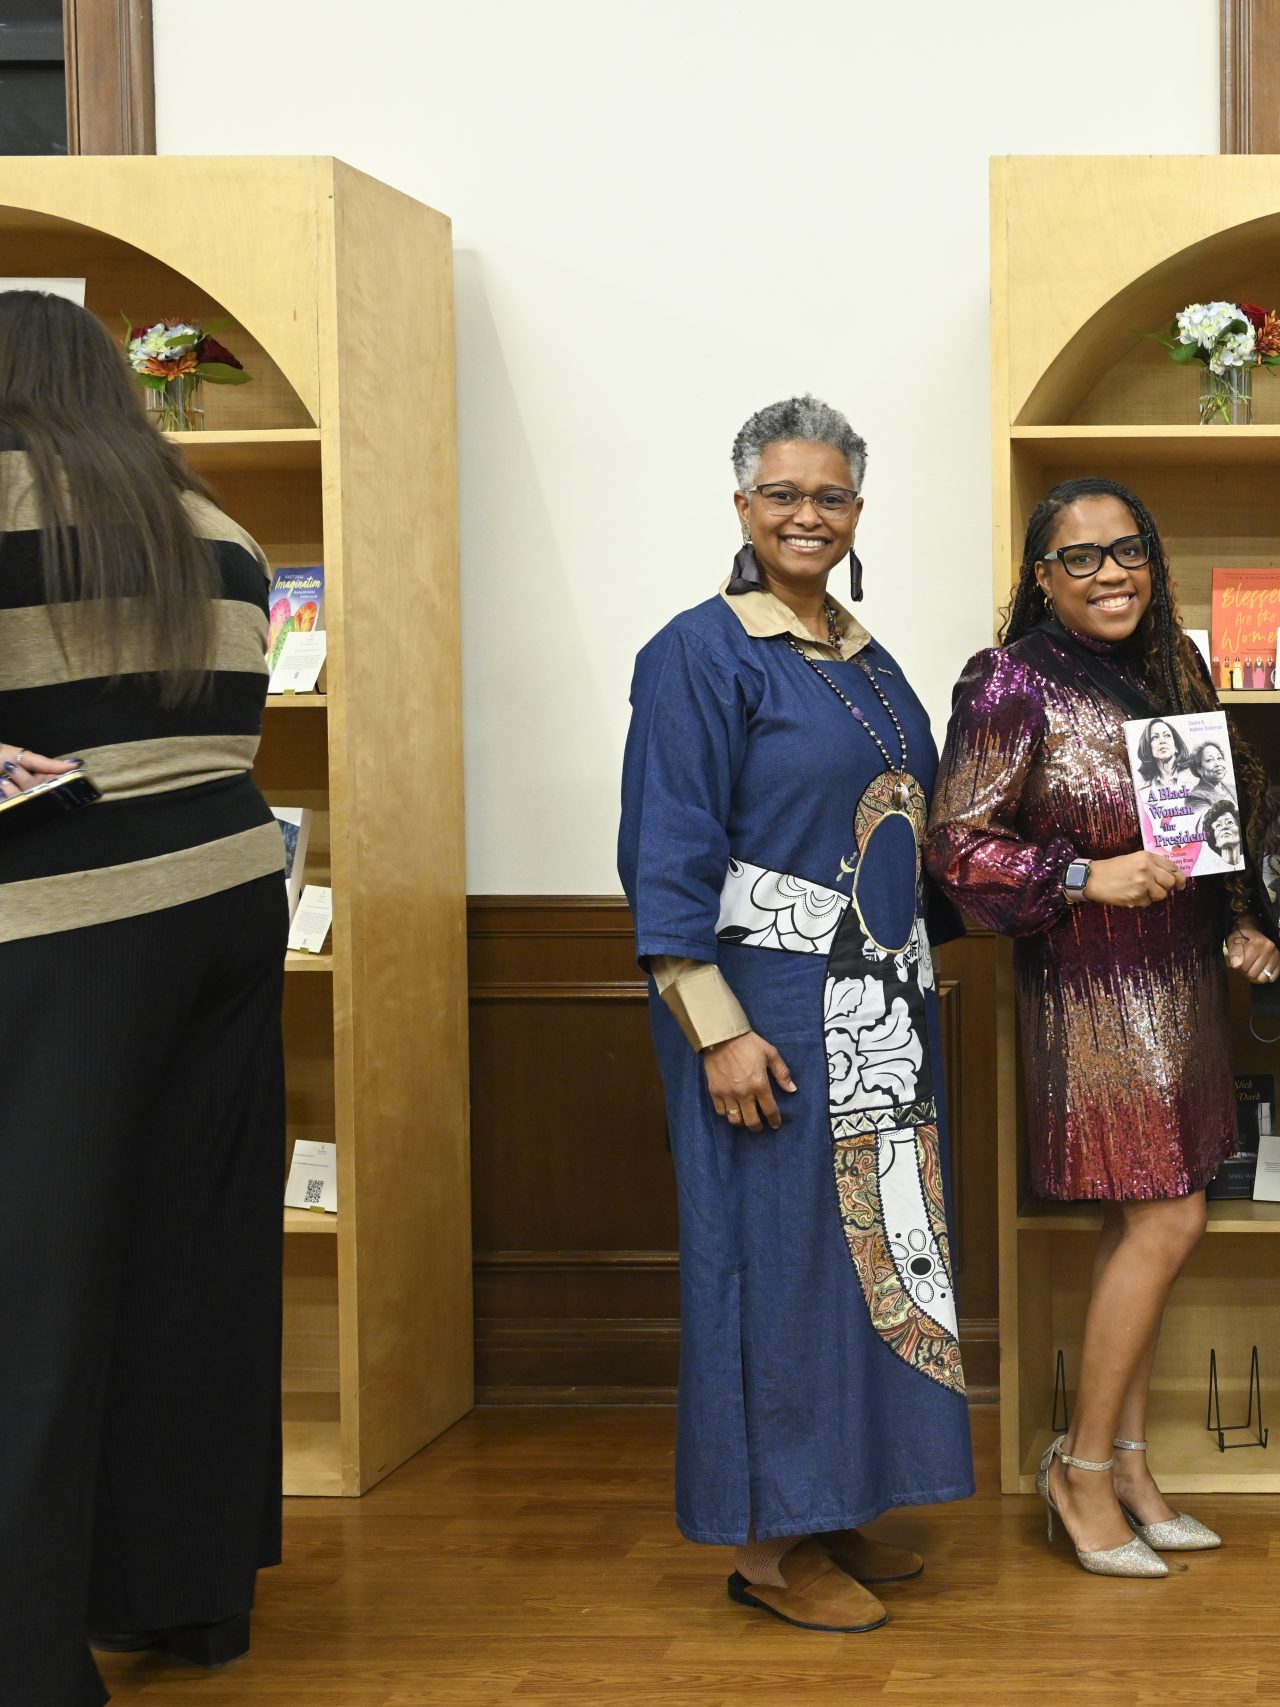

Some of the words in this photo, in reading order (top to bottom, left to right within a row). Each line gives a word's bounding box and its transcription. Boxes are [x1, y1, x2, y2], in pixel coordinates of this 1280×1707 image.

[274, 576, 322, 598] Imagination
[1236, 612, 1252, 628] Are
[1257, 607, 1276, 626] the
[1222, 625, 1277, 658] Wome
[1148, 789, 1158, 803] A
[1158, 785, 1192, 801] Black
[1149, 804, 1194, 820] Woman
[1162, 823, 1176, 832] for
[1154, 831, 1208, 848] President
[1237, 1091, 1261, 1102] Dark
